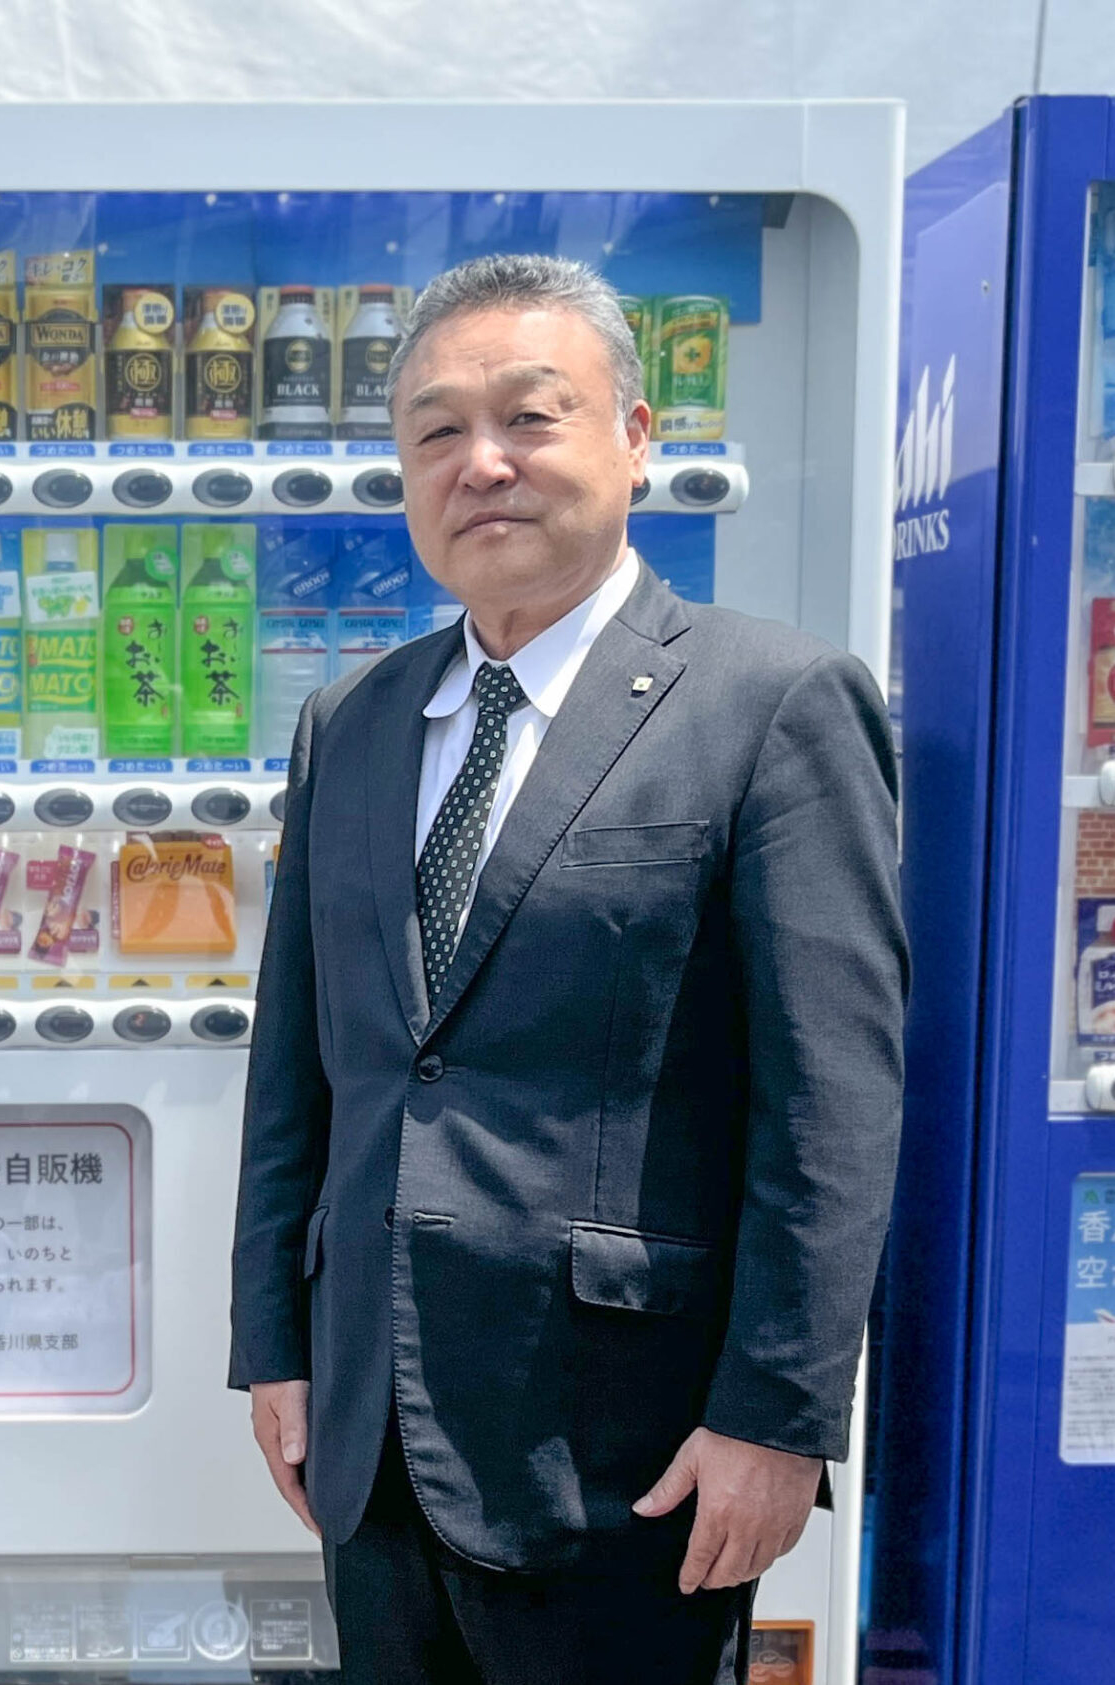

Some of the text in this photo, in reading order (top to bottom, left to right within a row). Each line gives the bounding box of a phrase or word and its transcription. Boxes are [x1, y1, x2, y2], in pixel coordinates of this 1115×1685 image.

[35, 325, 83, 341] WONDA
[277, 384, 320, 396] BLACK
[356, 384, 387, 396] BLAC
[895, 353, 955, 513] ahi
[893, 509, 950, 560] RINKS
[125, 640, 165, 707] お茶
[200, 640, 241, 707] お茶
[1078, 1210, 1115, 1243] 香
[1075, 1256, 1115, 1288] 空
